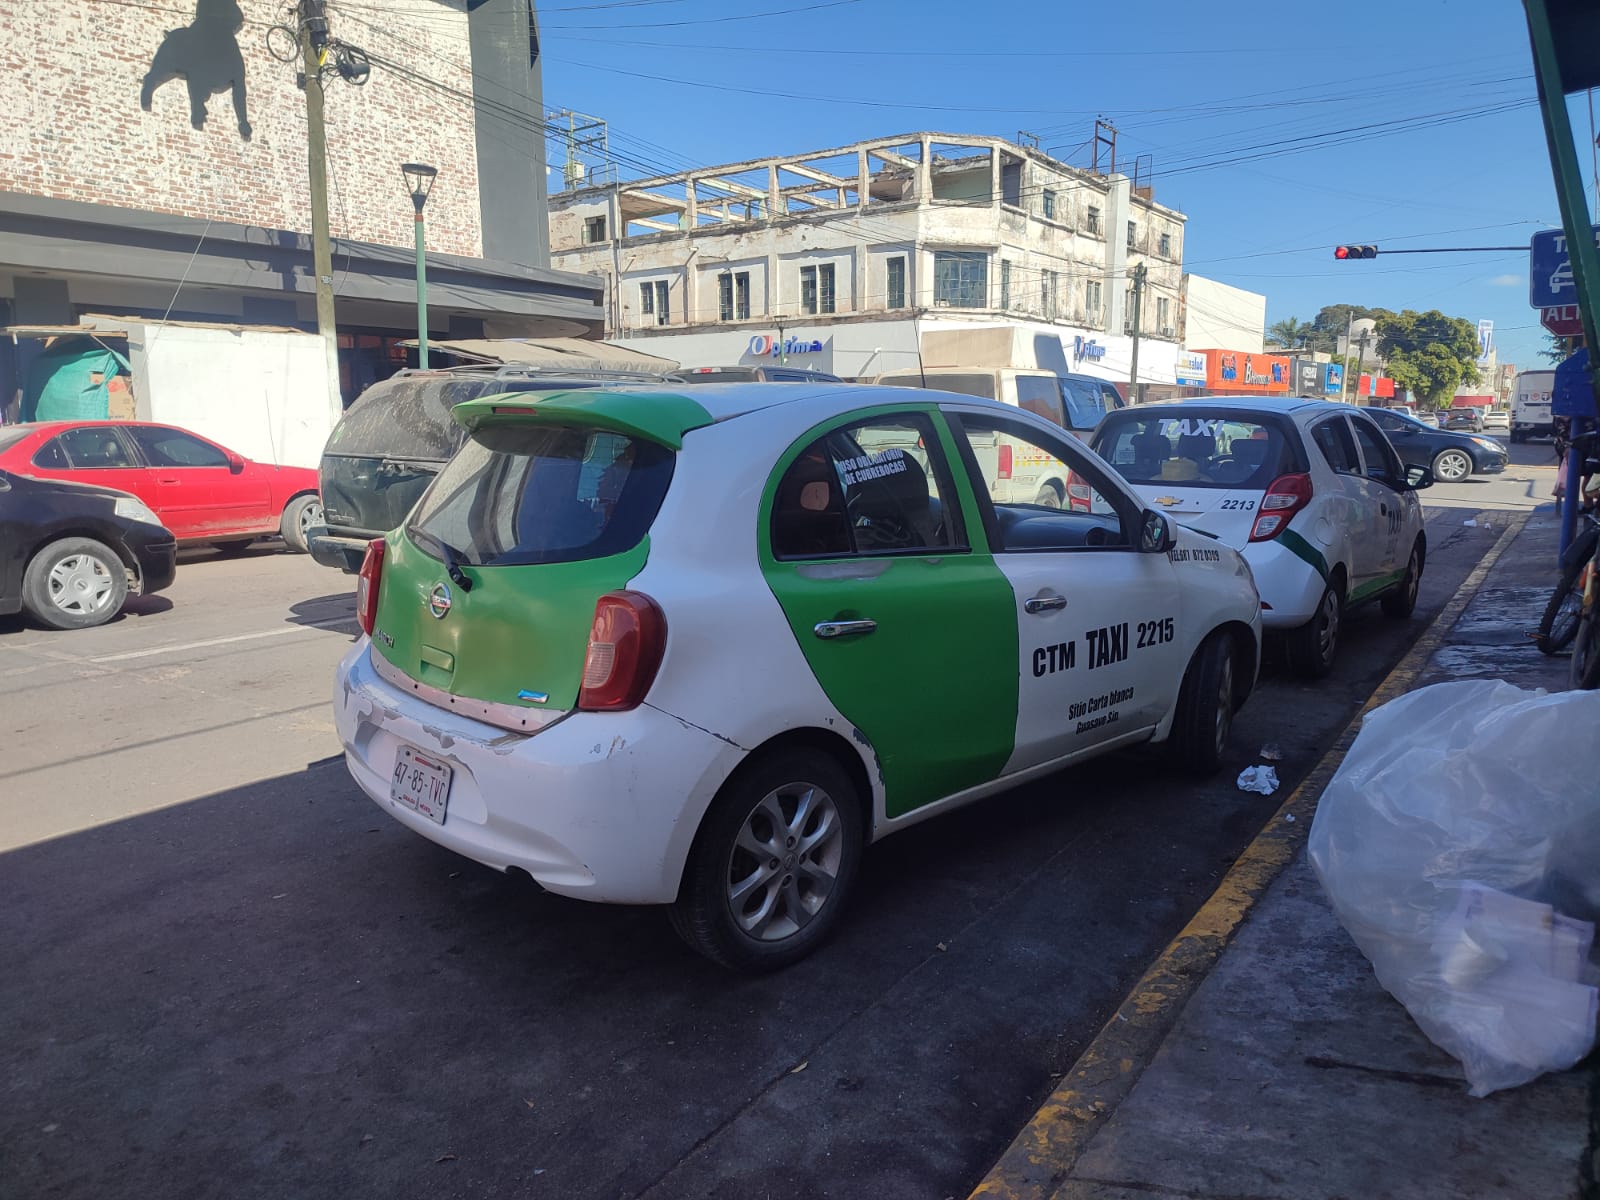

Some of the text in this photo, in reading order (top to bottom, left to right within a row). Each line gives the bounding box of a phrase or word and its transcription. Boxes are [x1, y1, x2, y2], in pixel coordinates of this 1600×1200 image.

[1158, 418, 1225, 437] TAXI
[845, 460, 908, 486] DE CUBREBOCAS!
[1220, 500, 1255, 511] 2213
[1032, 617, 1175, 678] CTM TAXI 2215
[1068, 686, 1135, 721] Sitio Carta blanca
[1075, 714, 1107, 735] Guasave
